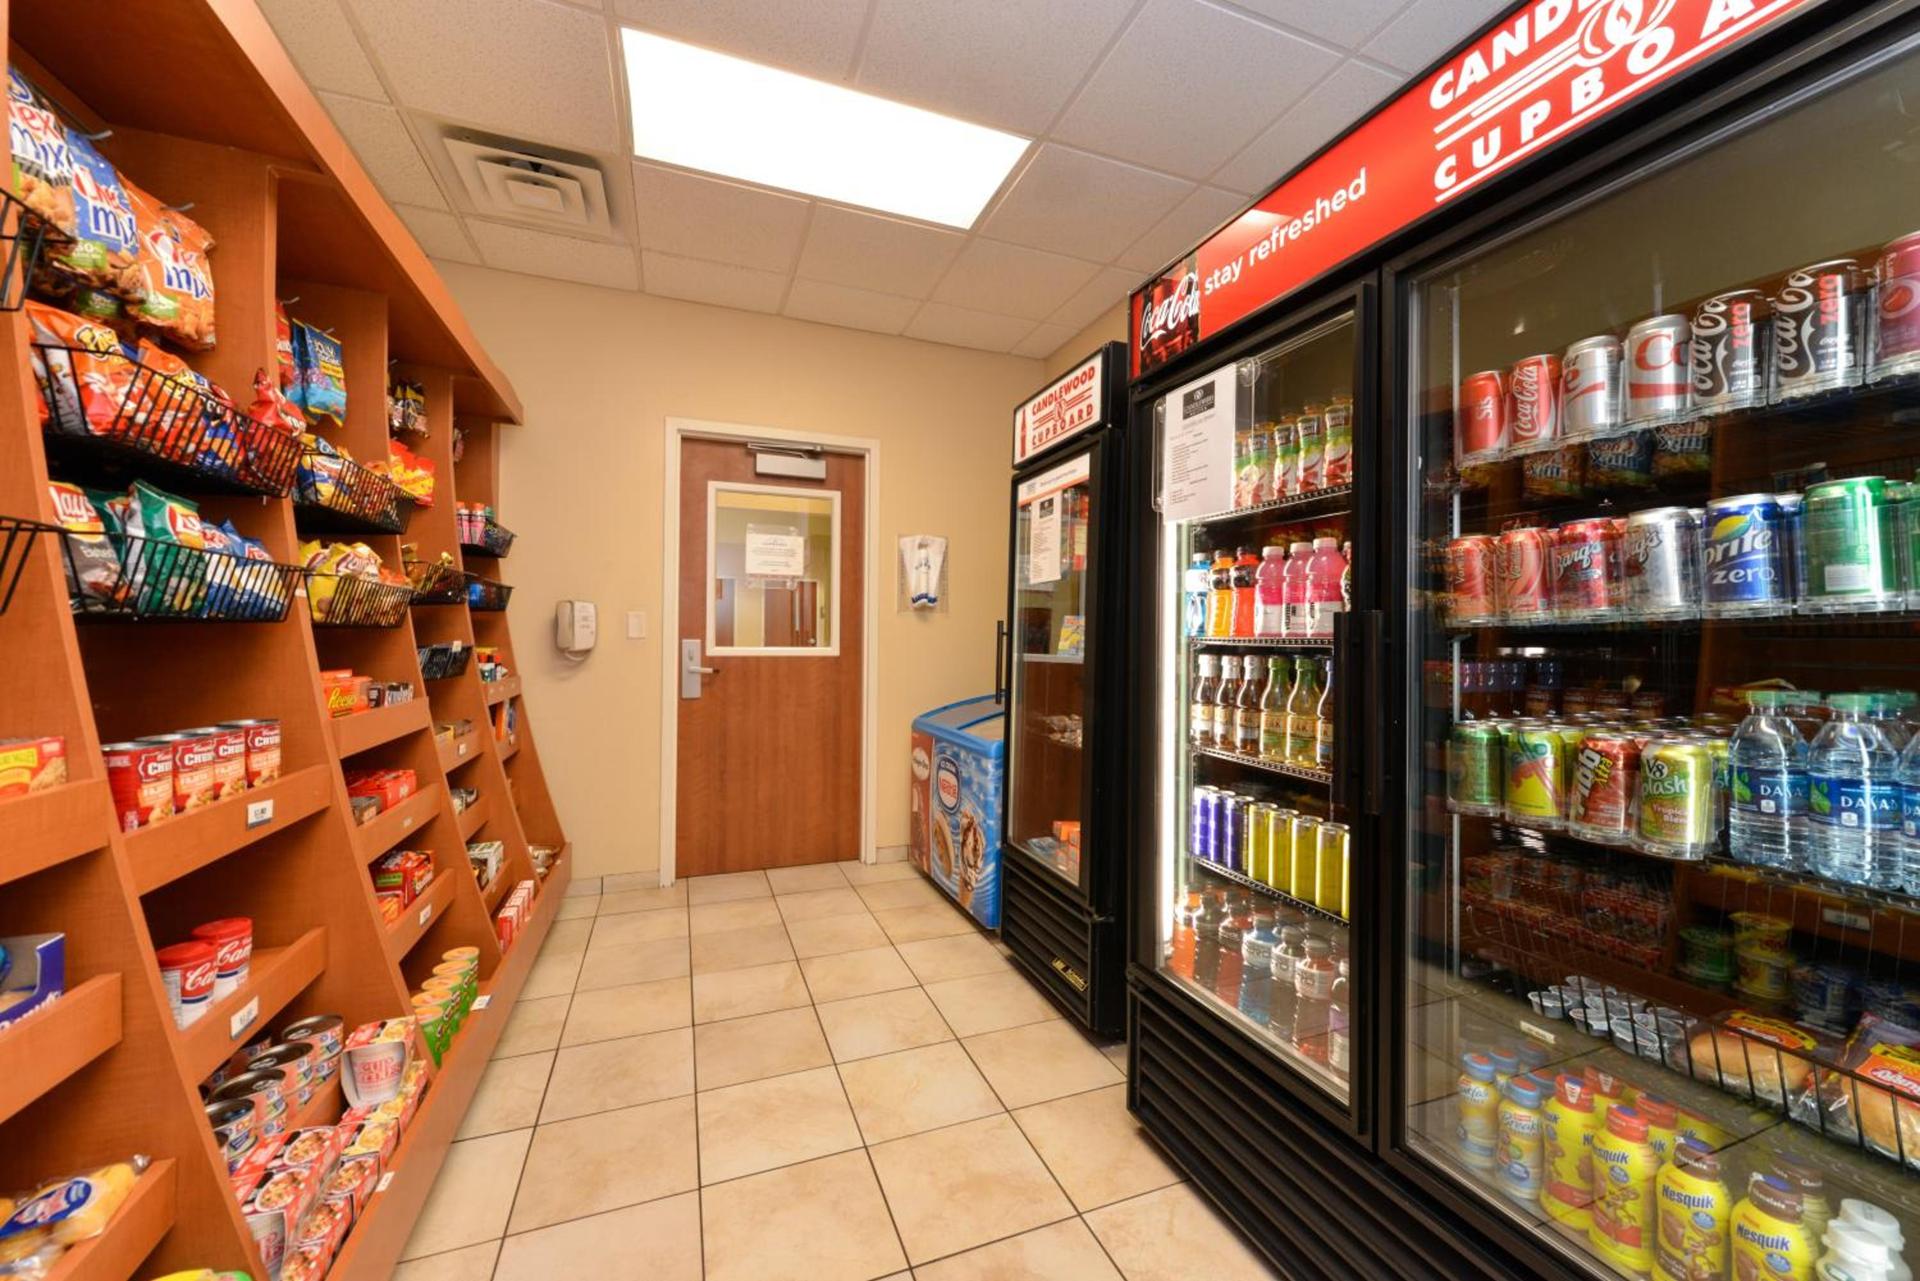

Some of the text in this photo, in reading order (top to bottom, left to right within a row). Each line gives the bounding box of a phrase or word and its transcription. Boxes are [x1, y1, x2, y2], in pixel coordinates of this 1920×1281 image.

[1429, 0, 1600, 110] CAND
[1205, 167, 1367, 295] stay refreshed
[1818, 275, 1838, 324] zero
[1731, 303, 1747, 348] zero
[1032, 366, 1095, 416] CANDLEWOOD
[1032, 403, 1094, 446] CUPBOARD
[1704, 520, 1772, 566] prite
[1712, 566, 1774, 585] zero
[1641, 775, 1689, 800] plash
[1645, 759, 1665, 779] V8
[1662, 1184, 1715, 1209] Nesquik
[1736, 1223, 1790, 1251] Nesquik
